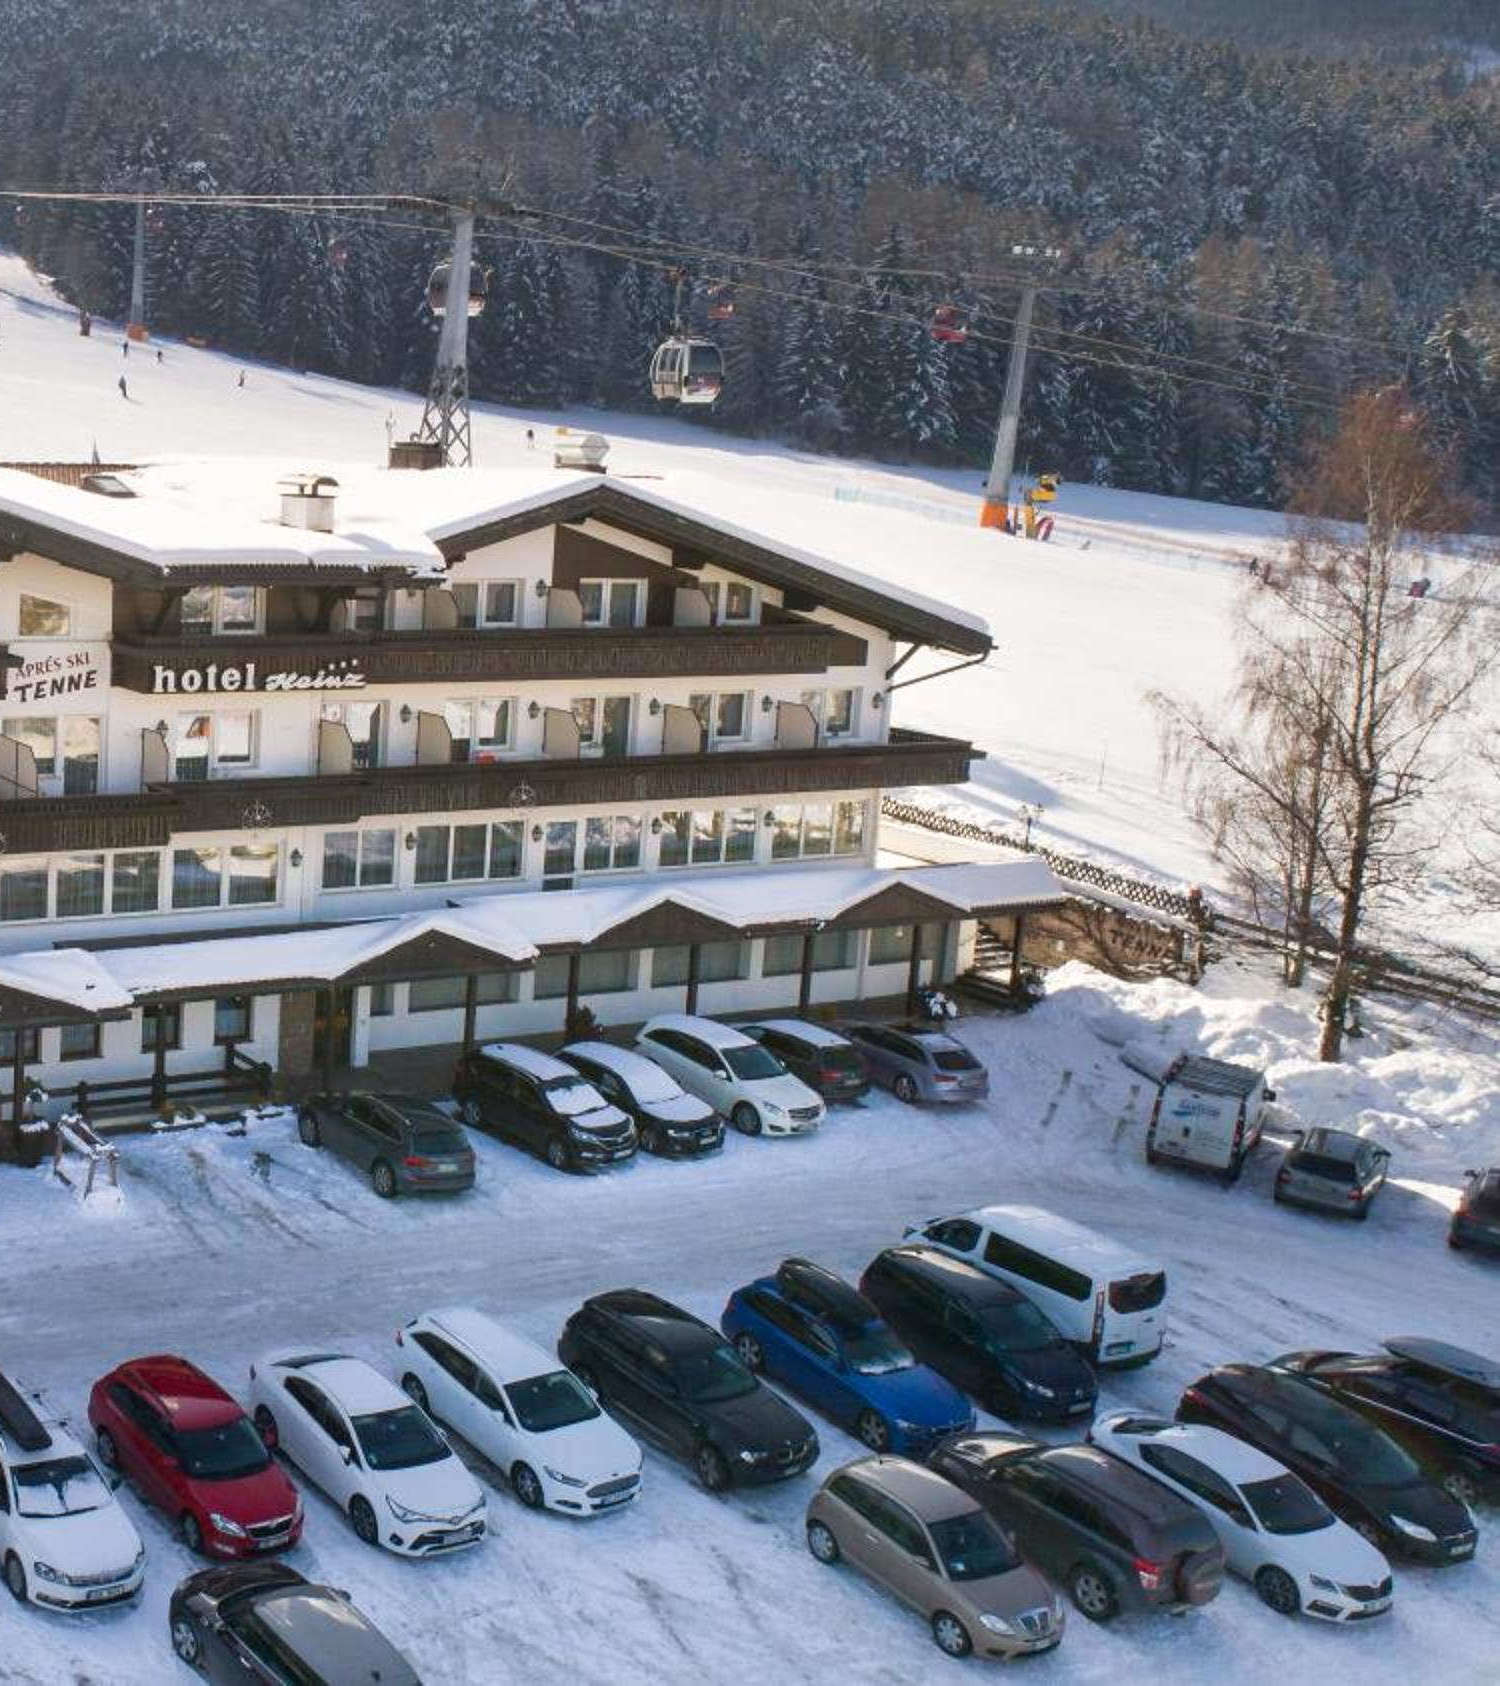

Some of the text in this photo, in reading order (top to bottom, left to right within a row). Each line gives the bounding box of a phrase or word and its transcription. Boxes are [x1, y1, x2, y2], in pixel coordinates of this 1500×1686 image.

[66, 652, 90, 669] SKI
[13, 670, 98, 703] TENNE
[153, 663, 256, 693] hotel
